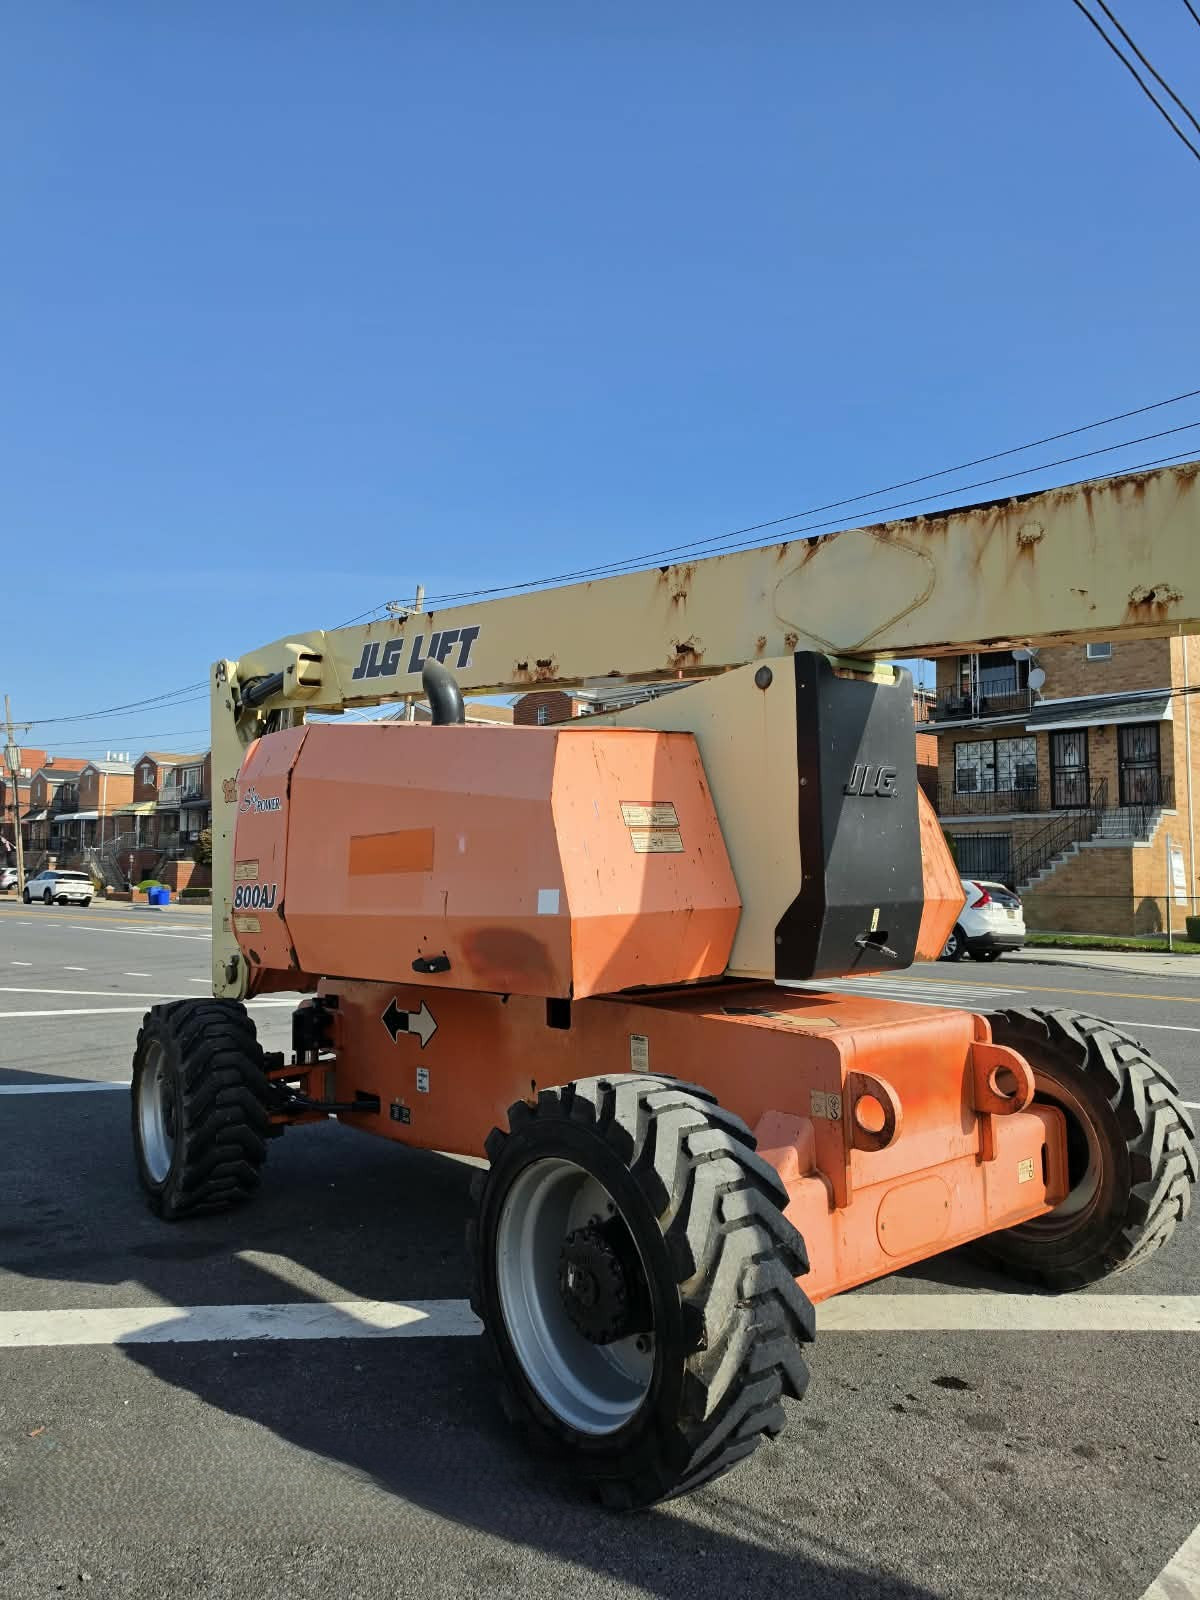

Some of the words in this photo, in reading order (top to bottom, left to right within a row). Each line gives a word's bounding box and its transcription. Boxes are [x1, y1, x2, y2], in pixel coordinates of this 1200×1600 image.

[352, 638, 404, 679] JLG
[407, 625, 480, 673] LIFT
[843, 764, 896, 797] JLG
[234, 884, 277, 909] 800AJ
